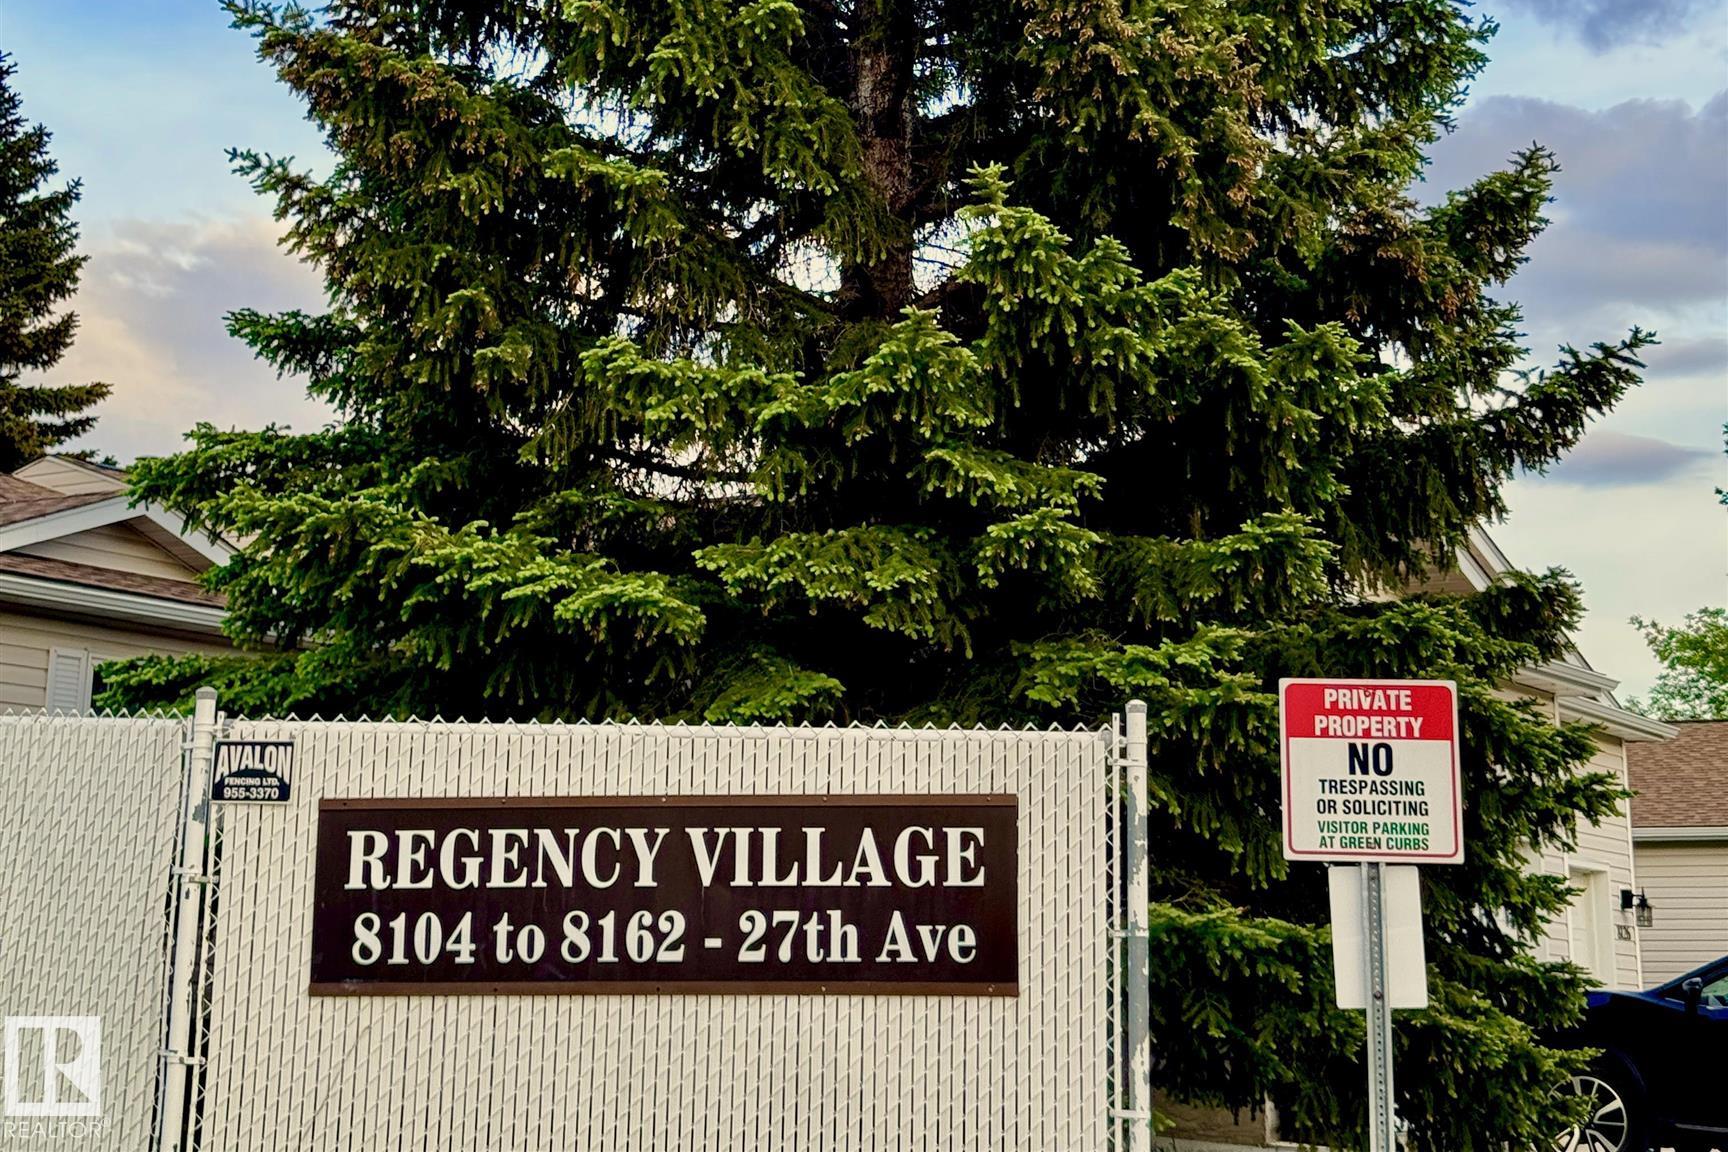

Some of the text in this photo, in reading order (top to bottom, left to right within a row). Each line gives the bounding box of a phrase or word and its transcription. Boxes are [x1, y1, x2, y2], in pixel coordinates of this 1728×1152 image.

[1323, 688, 1413, 711] PRIVATE
[1314, 715, 1423, 738] PROPERTY
[214, 744, 293, 785] AVALON
[1348, 742, 1394, 776] NO
[224, 777, 261, 786] FENCING
[1318, 779, 1425, 796] TRESPASSING
[223, 787, 280, 799] 955-3370
[1317, 799, 1429, 816] OR SOLICITING
[1317, 821, 1430, 836] VISITOR PARKING
[1319, 836, 1429, 850] AT GREEN CURBS
[344, 826, 985, 890] REGENCY VILLAGE
[352, 909, 977, 965] 8104 to 8162 - 27th Ave
